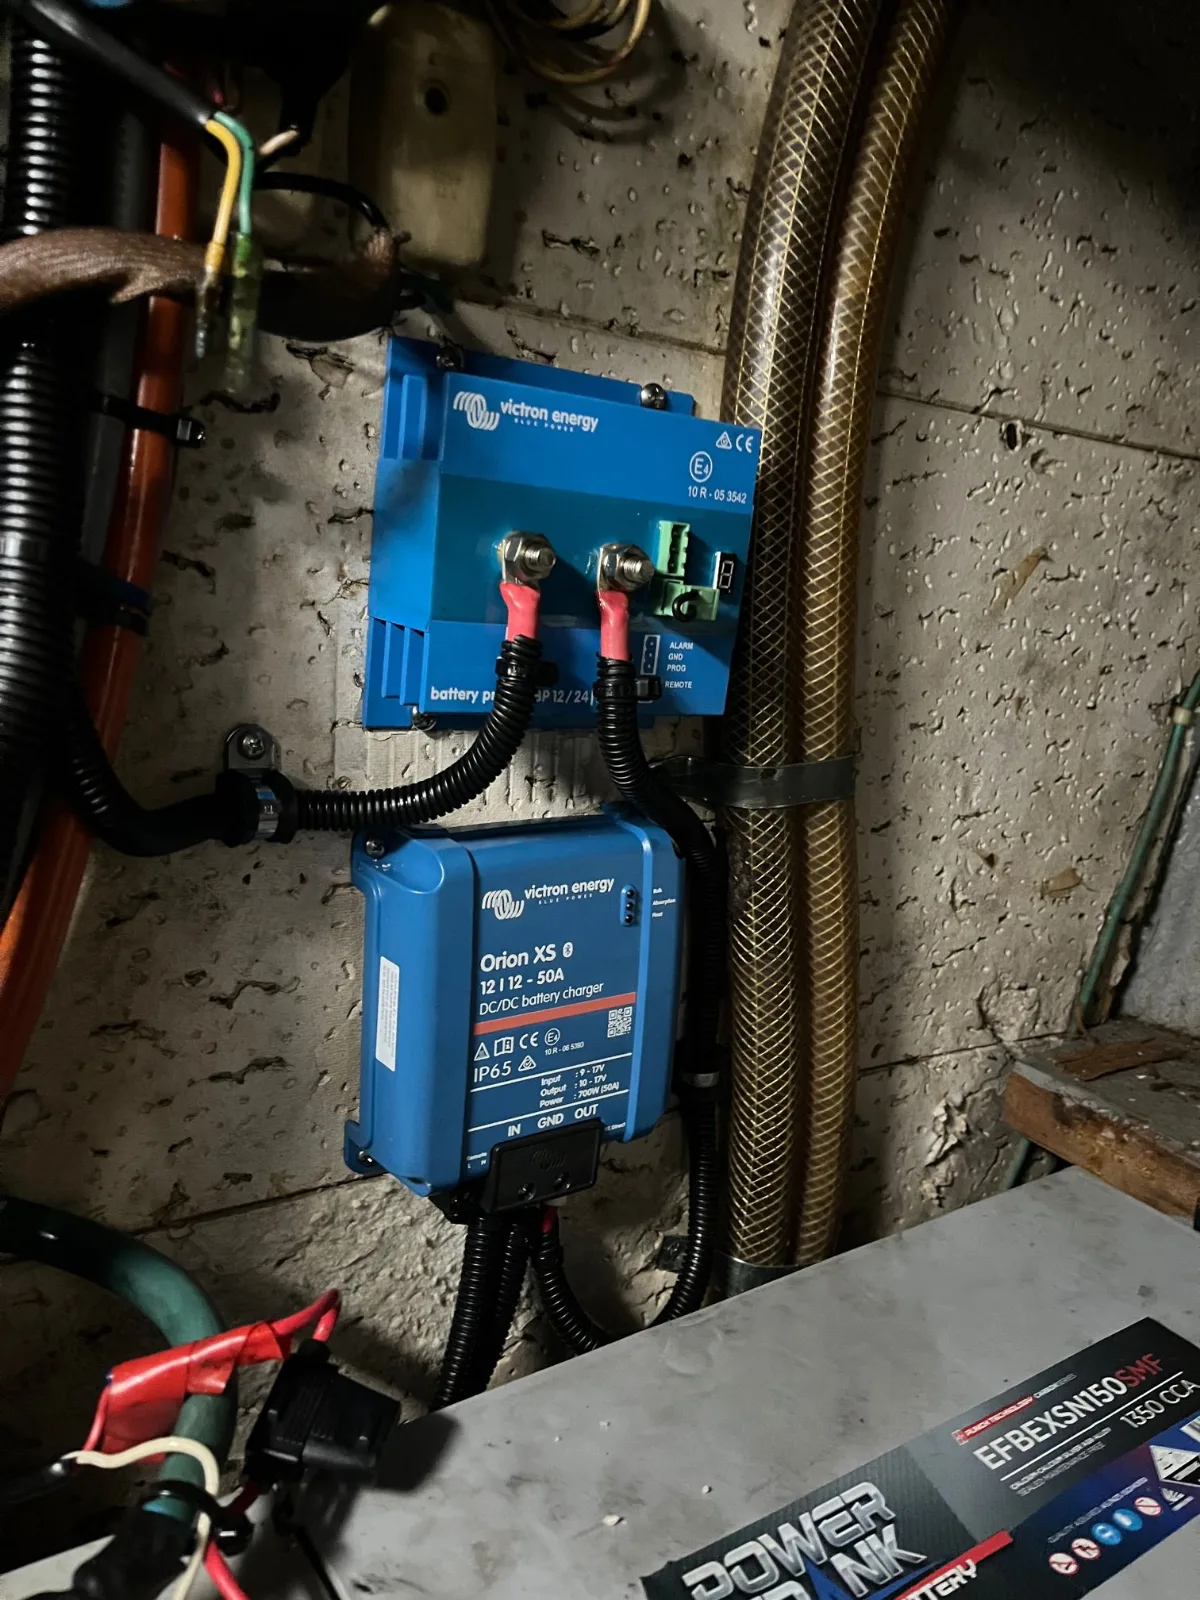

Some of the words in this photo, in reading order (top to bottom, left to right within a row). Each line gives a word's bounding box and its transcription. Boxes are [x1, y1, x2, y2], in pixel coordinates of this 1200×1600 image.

[501, 398, 549, 421] victron
[552, 410, 599, 433] energy
[688, 485, 698, 498] 10
[700, 486, 708, 499] R
[714, 488, 725, 501] 05
[726, 489, 748, 505] 3542
[668, 652, 684, 661] GND
[669, 641, 694, 650] ALARM
[666, 663, 687, 672] PROG
[430, 685, 479, 705] battery
[664, 680, 693, 689] REMOTE
[524, 884, 568, 901] victron
[571, 877, 615, 894] energy
[480, 950, 529, 973] Orion
[533, 943, 557, 964] XS
[480, 979, 496, 995] 12
[507, 974, 523, 990] 12
[536, 967, 565, 985] 50A
[479, 996, 519, 1015] DC/DC
[522, 991, 560, 1006] battery
[562, 982, 604, 1000] charger
[473, 1060, 512, 1082] IP65
[541, 1074, 562, 1087] Input
[580, 1068, 585, 1077] 9
[592, 1064, 606, 1074] 17V
[539, 1096, 564, 1108] Power
[578, 1087, 600, 1099] 700W
[600, 1082, 620, 1094] (50A)
[540, 1083, 567, 1097] Output
[579, 1079, 588, 1088] 10
[593, 1074, 607, 1084] 17V
[507, 1123, 521, 1137] IN
[537, 1113, 564, 1129] GND
[574, 1103, 599, 1119] OUT
[972, 1352, 1164, 1470] EFBEXSN150SMF
[1120, 1399, 1165, 1429] 1350
[1159, 1379, 1200, 1404] CCA
[682, 1481, 896, 1600] POWER
